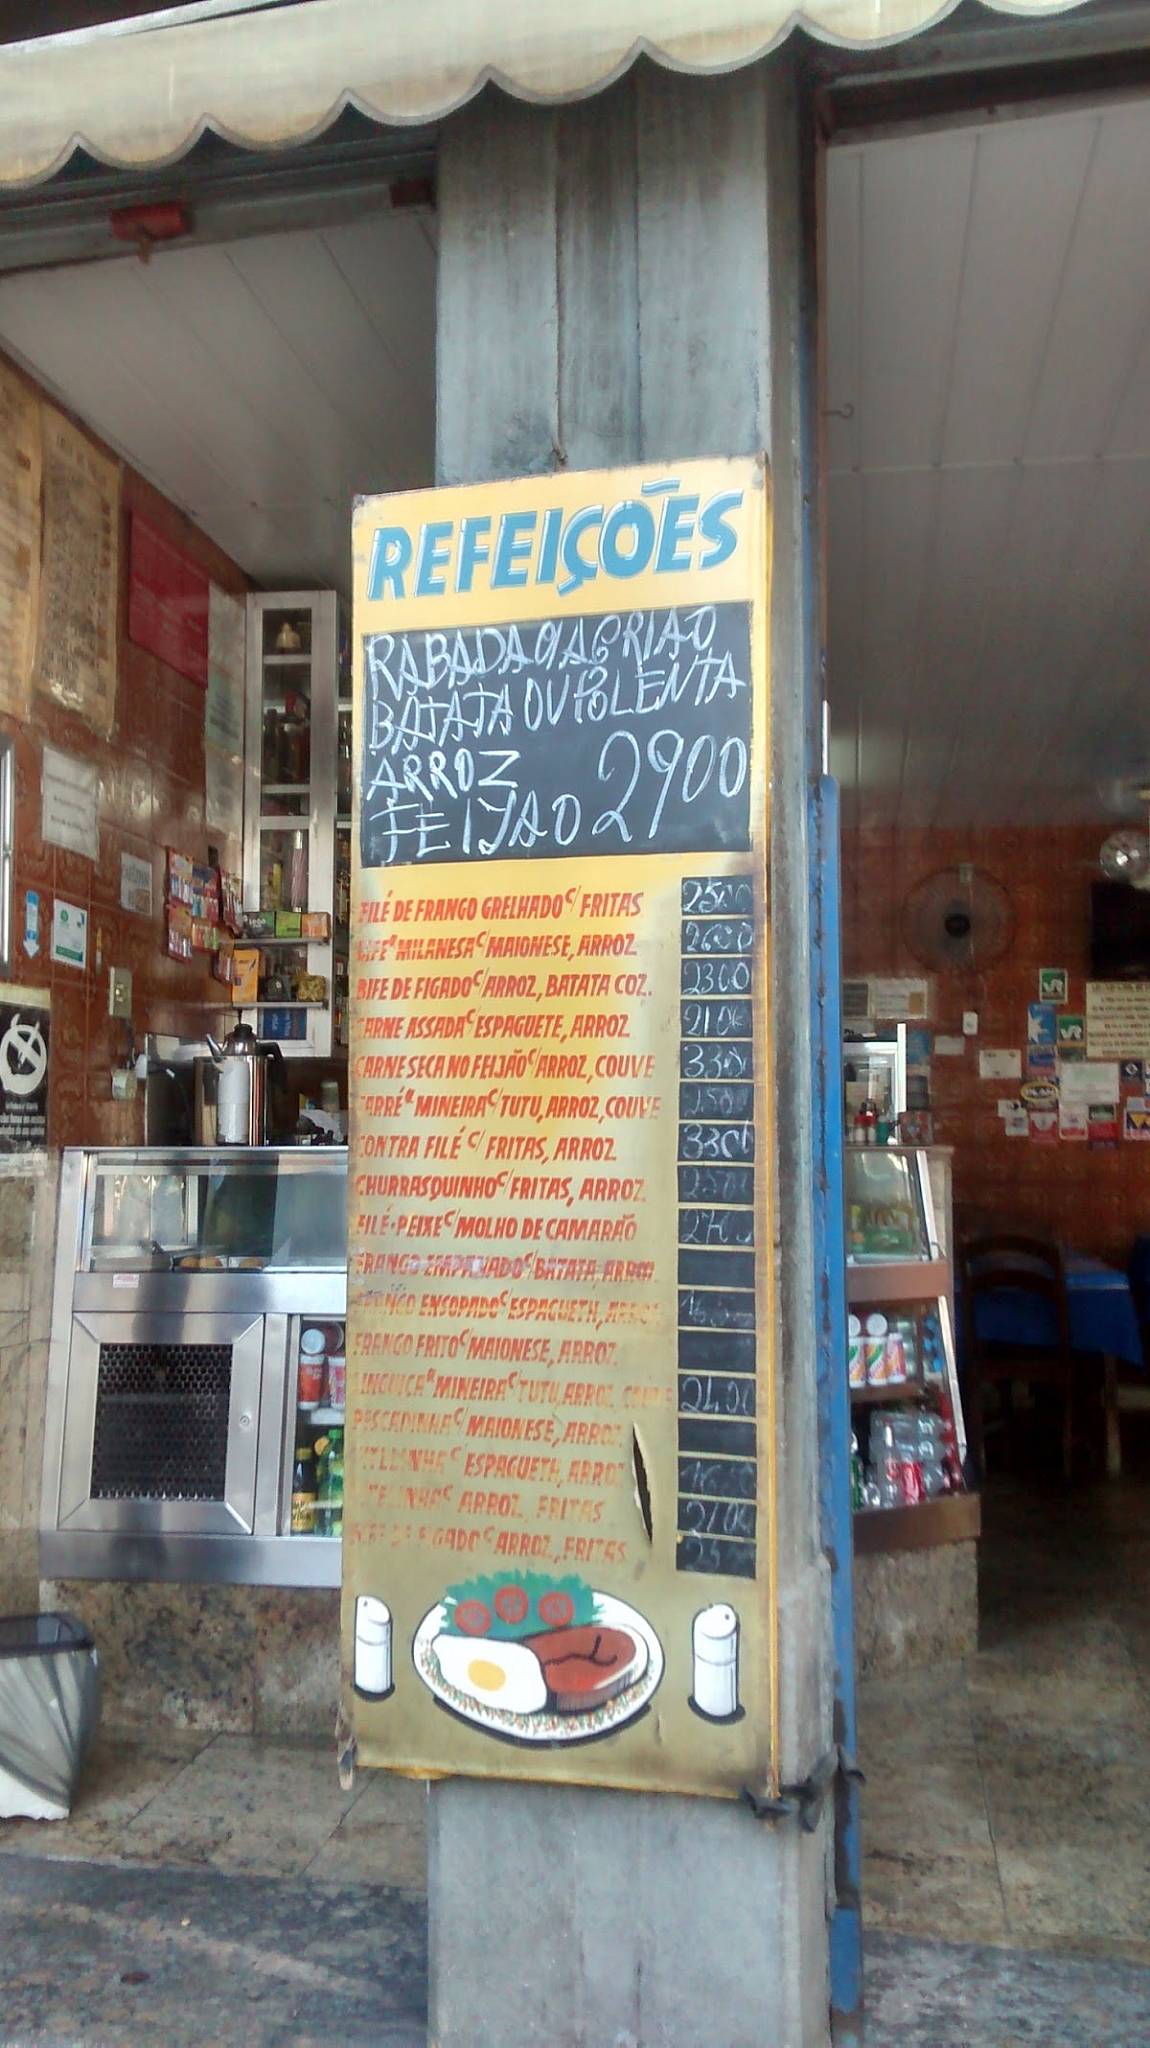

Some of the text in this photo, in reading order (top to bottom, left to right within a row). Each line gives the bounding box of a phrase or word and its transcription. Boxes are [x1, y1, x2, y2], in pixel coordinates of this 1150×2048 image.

[368, 480, 744, 600] REFEIÇÕES
[366, 625, 533, 700] RABADA
[369, 648, 747, 756] BATATA OU POLENTA
[366, 749, 521, 802] ARROZ
[591, 729, 749, 842] 2900
[393, 896, 413, 923] DE
[414, 896, 478, 922] FRANGO
[481, 893, 563, 920] GRELHADO
[579, 891, 644, 919] FRITAS
[396, 934, 475, 961] MILANESA
[356, 977, 389, 1001] BIFE
[391, 976, 413, 1001] DE
[544, 973, 610, 997] BATATA
[406, 1014, 467, 1040] ASSADA
[356, 1055, 407, 1079] CARNE
[406, 1055, 445, 1078] SECA
[446, 1055, 469, 1078] NO
[470, 1049, 527, 1079] FEIJÃO
[594, 1054, 656, 1078] COUVE
[414, 1094, 488, 1118] MINEIRA
[423, 1126, 467, 1160] FILÉ
[356, 1174, 499, 1202] CHURRASQUINHO
[454, 1216, 519, 1240] MOLHO
[520, 1217, 544, 1241] DE
[545, 1213, 638, 1242] CAMARÃO
[415, 1332, 459, 1360] FRITO
[433, 1374, 509, 1401] MINEIRA
